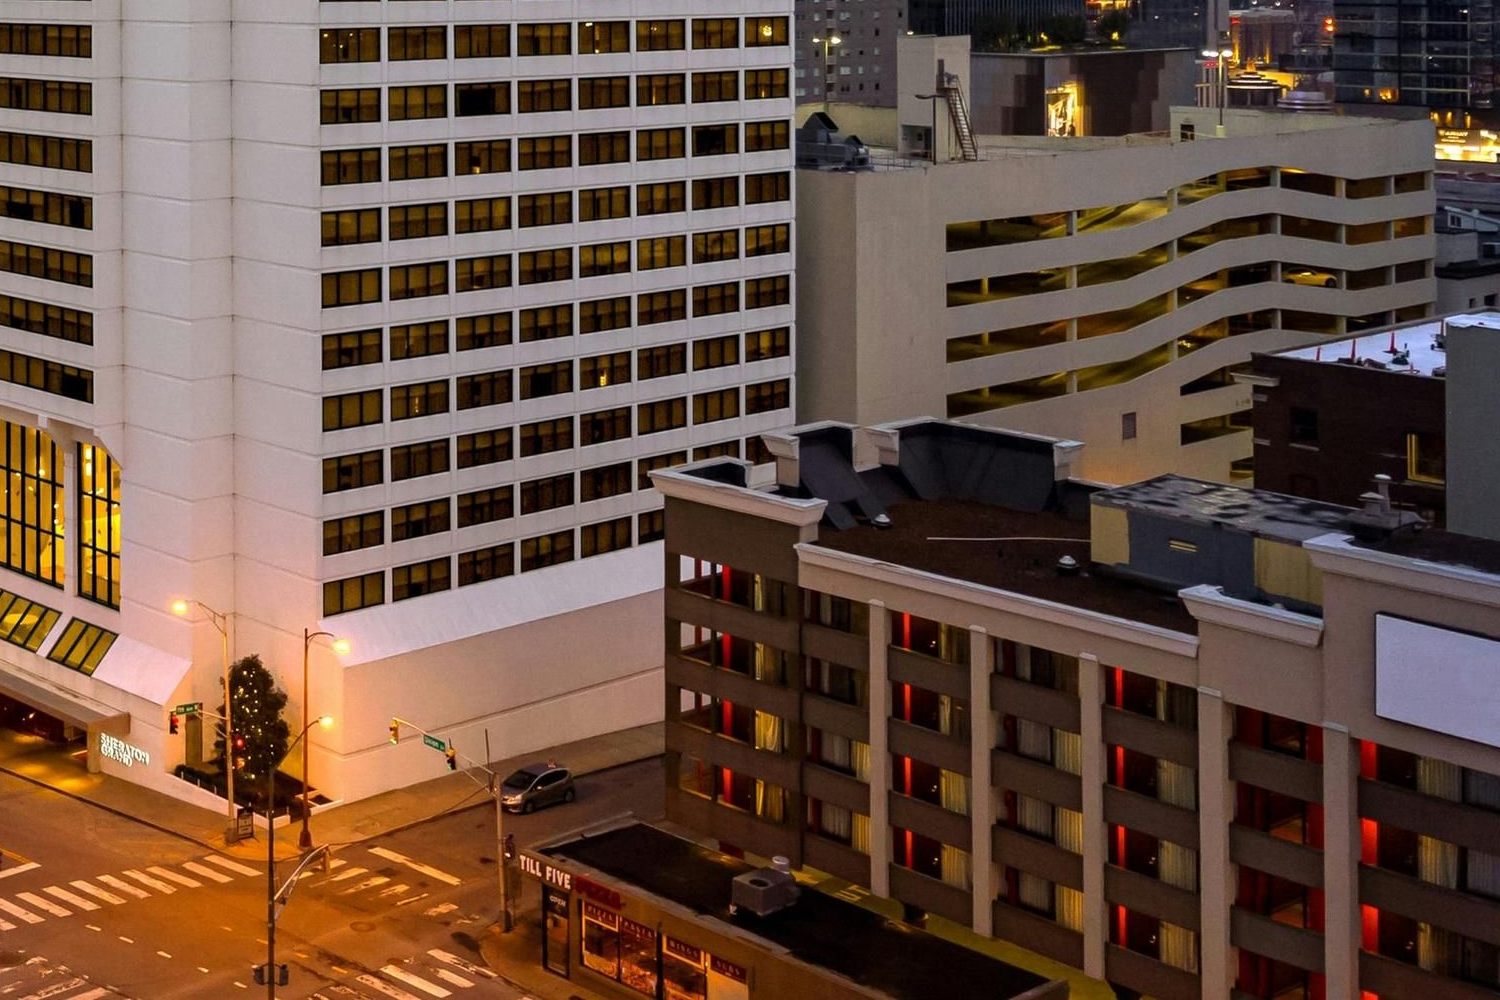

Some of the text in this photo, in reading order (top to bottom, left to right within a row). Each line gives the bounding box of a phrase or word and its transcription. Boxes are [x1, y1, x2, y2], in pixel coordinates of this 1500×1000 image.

[100, 731, 150, 766] SHERATON
[520, 855, 571, 890] TILL FIVE
[549, 895, 567, 907] OPEN
[624, 921, 653, 938] PASTA
